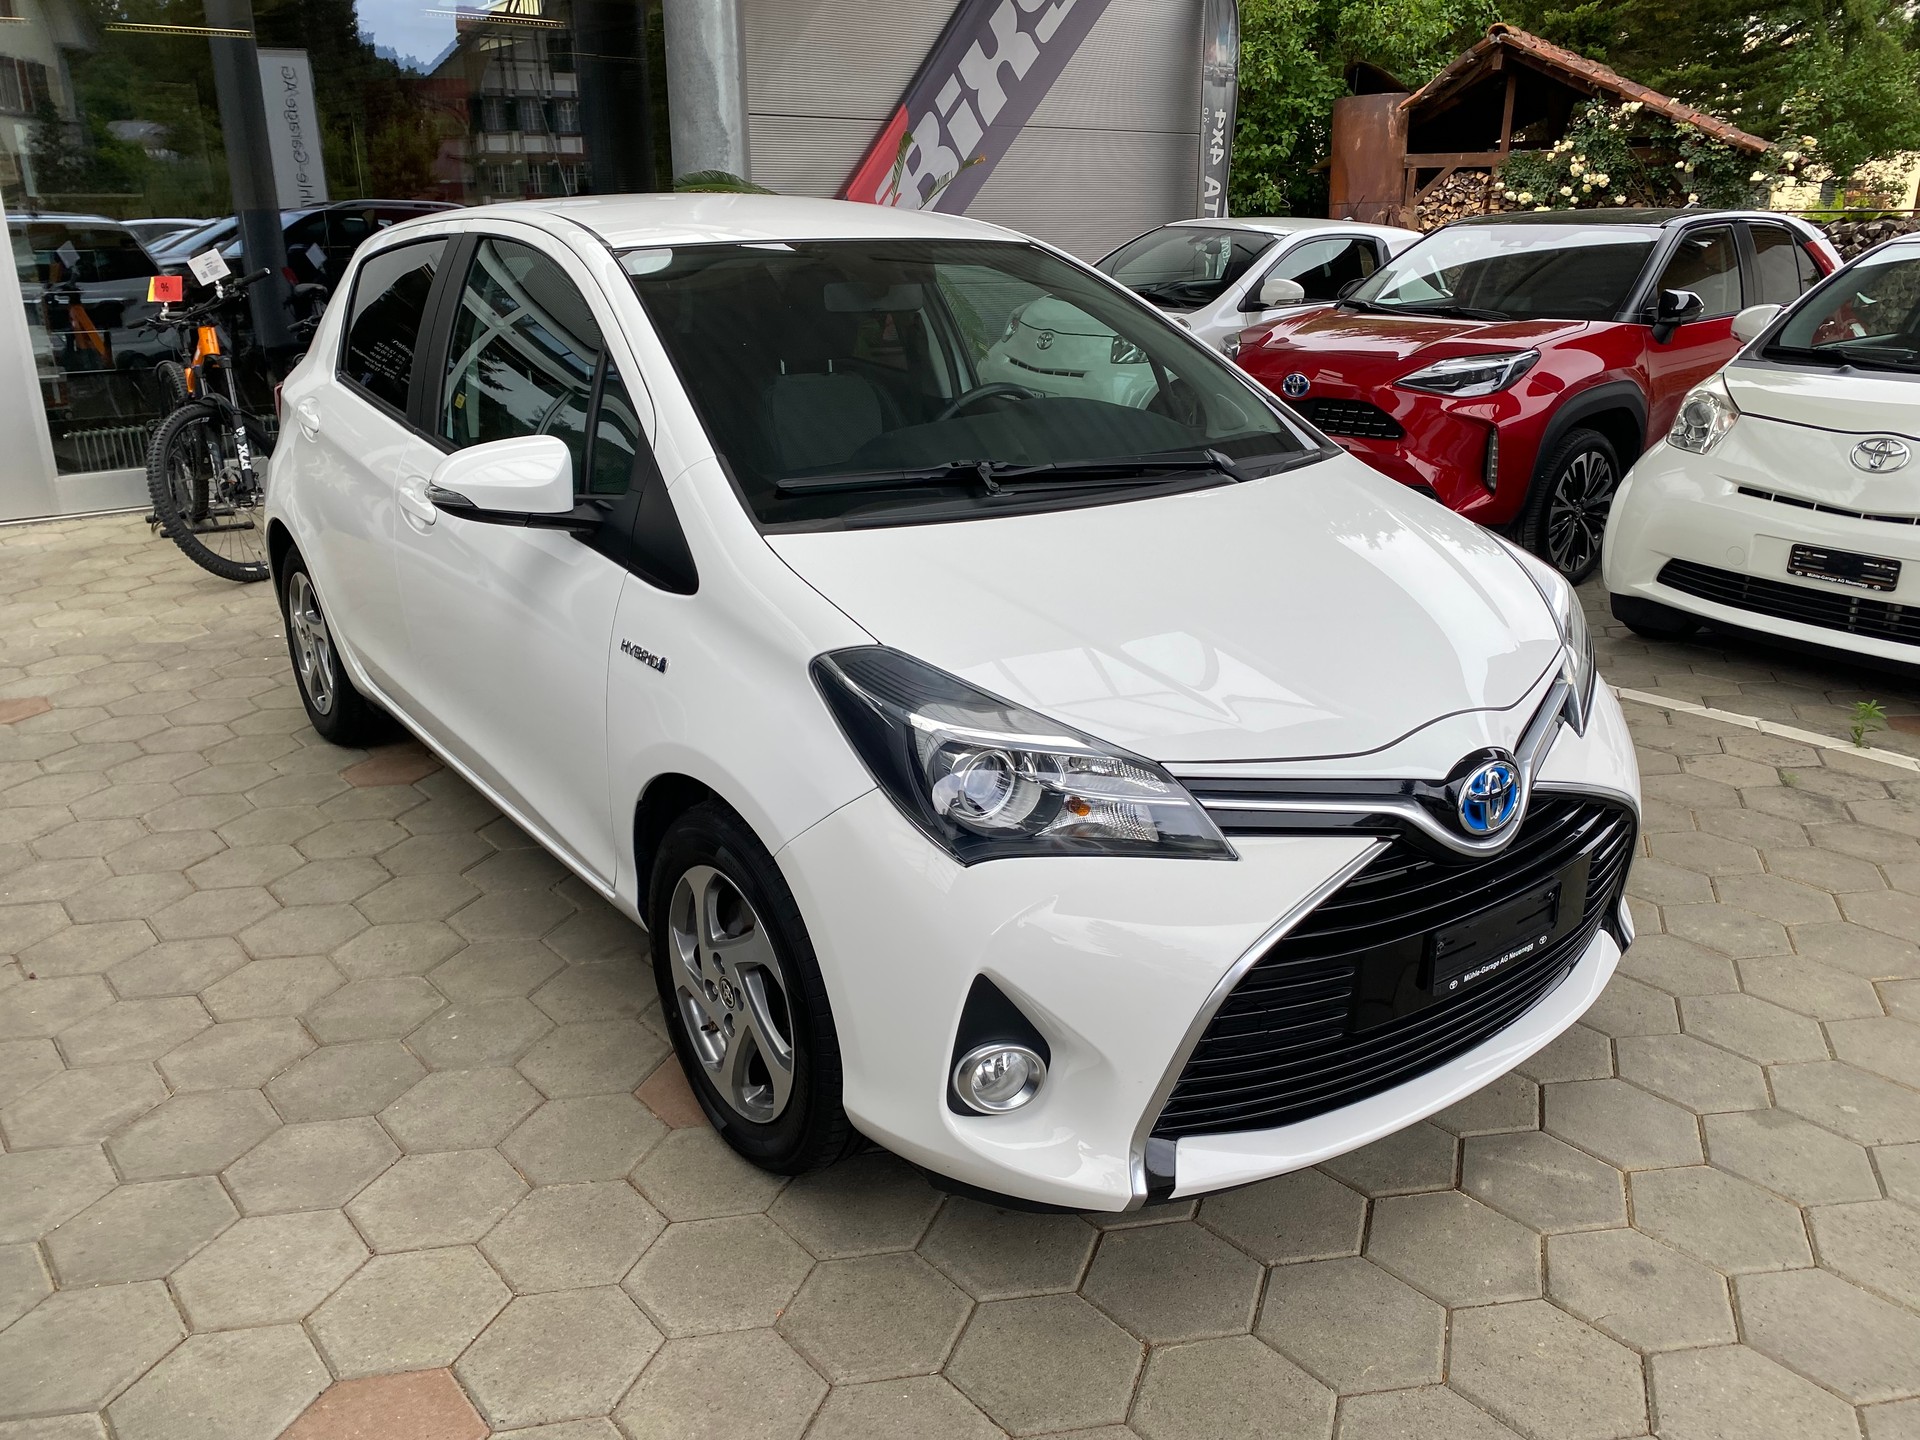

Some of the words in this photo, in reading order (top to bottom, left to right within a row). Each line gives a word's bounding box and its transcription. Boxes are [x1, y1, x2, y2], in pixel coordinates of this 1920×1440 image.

[236, 443, 252, 471] FOX
[620, 638, 659, 669] HYBRID
[1464, 960, 1500, 982] Mühle-Garage
[1500, 954, 1509, 965] AG
[1509, 943, 1534, 960] Neuenegg
